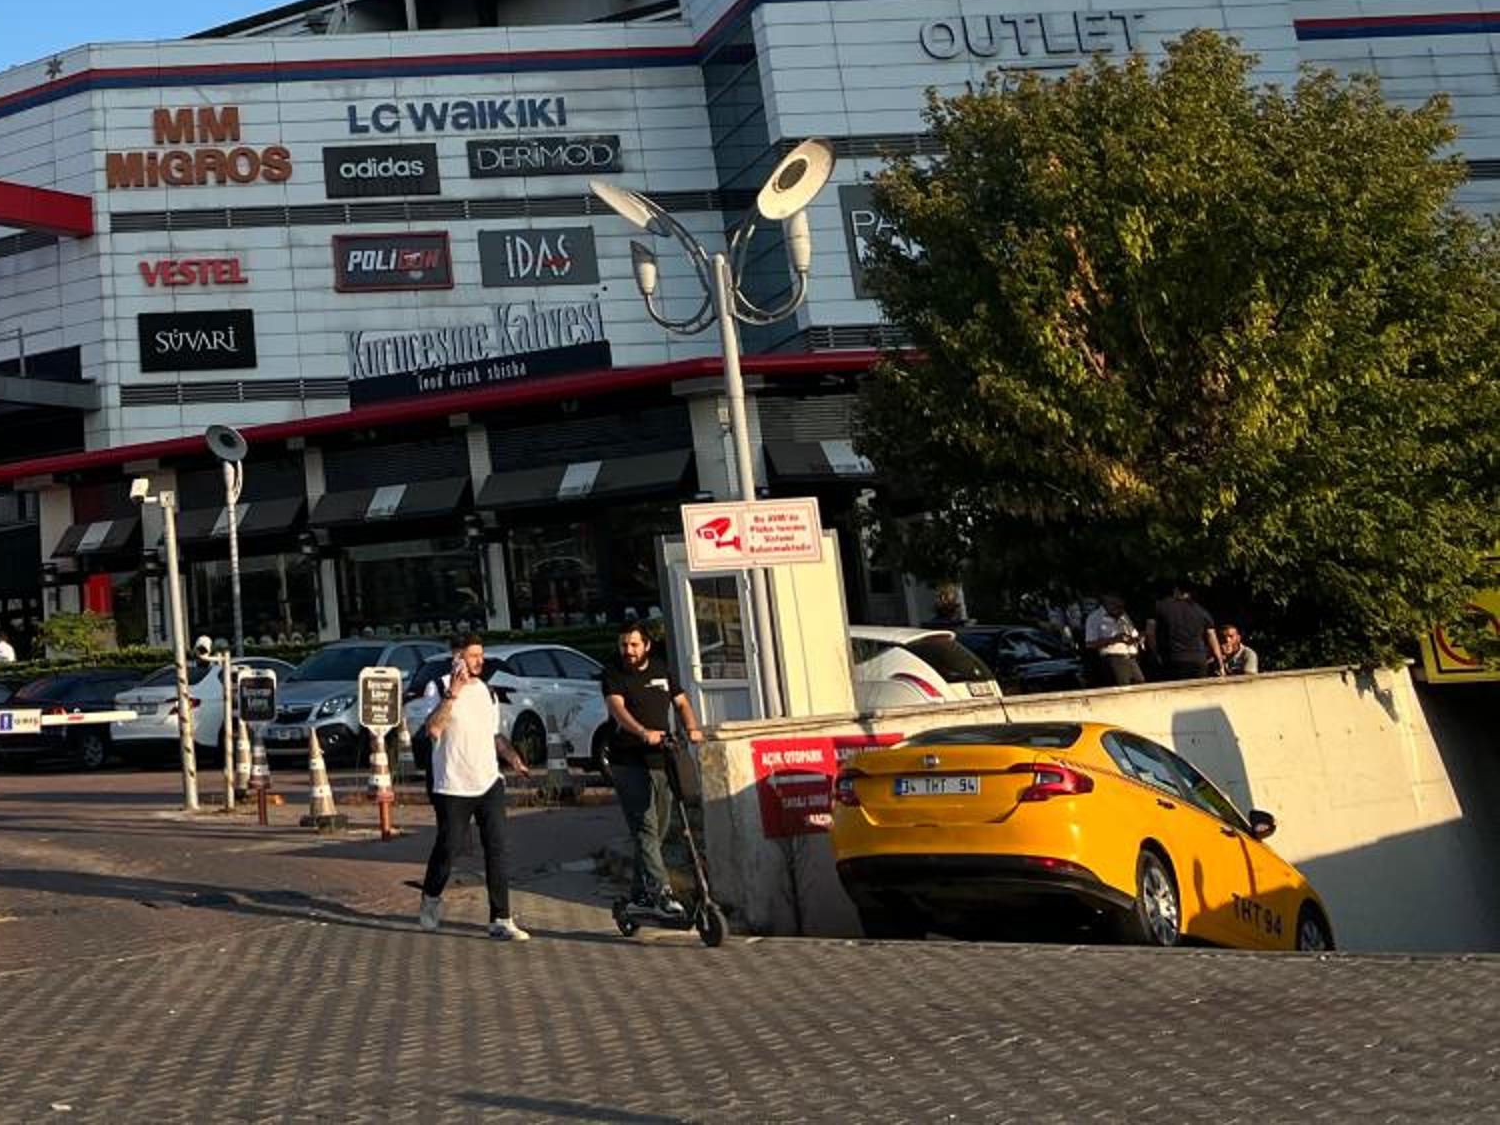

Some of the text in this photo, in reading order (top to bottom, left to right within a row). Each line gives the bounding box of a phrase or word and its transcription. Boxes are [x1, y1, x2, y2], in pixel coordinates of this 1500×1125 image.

[919, 10, 1145, 60] OUTLET
[153, 106, 240, 144] MM
[347, 103, 400, 134] LC
[340, 158, 424, 178] adidas
[139, 258, 248, 286] VESTEL
[155, 326, 238, 353] SÜVARİ
[784, 749, 824, 764] OTOPARK
[925, 778, 947, 792] THT
[958, 777, 975, 792] 94
[1231, 892, 1285, 939] THT 94
